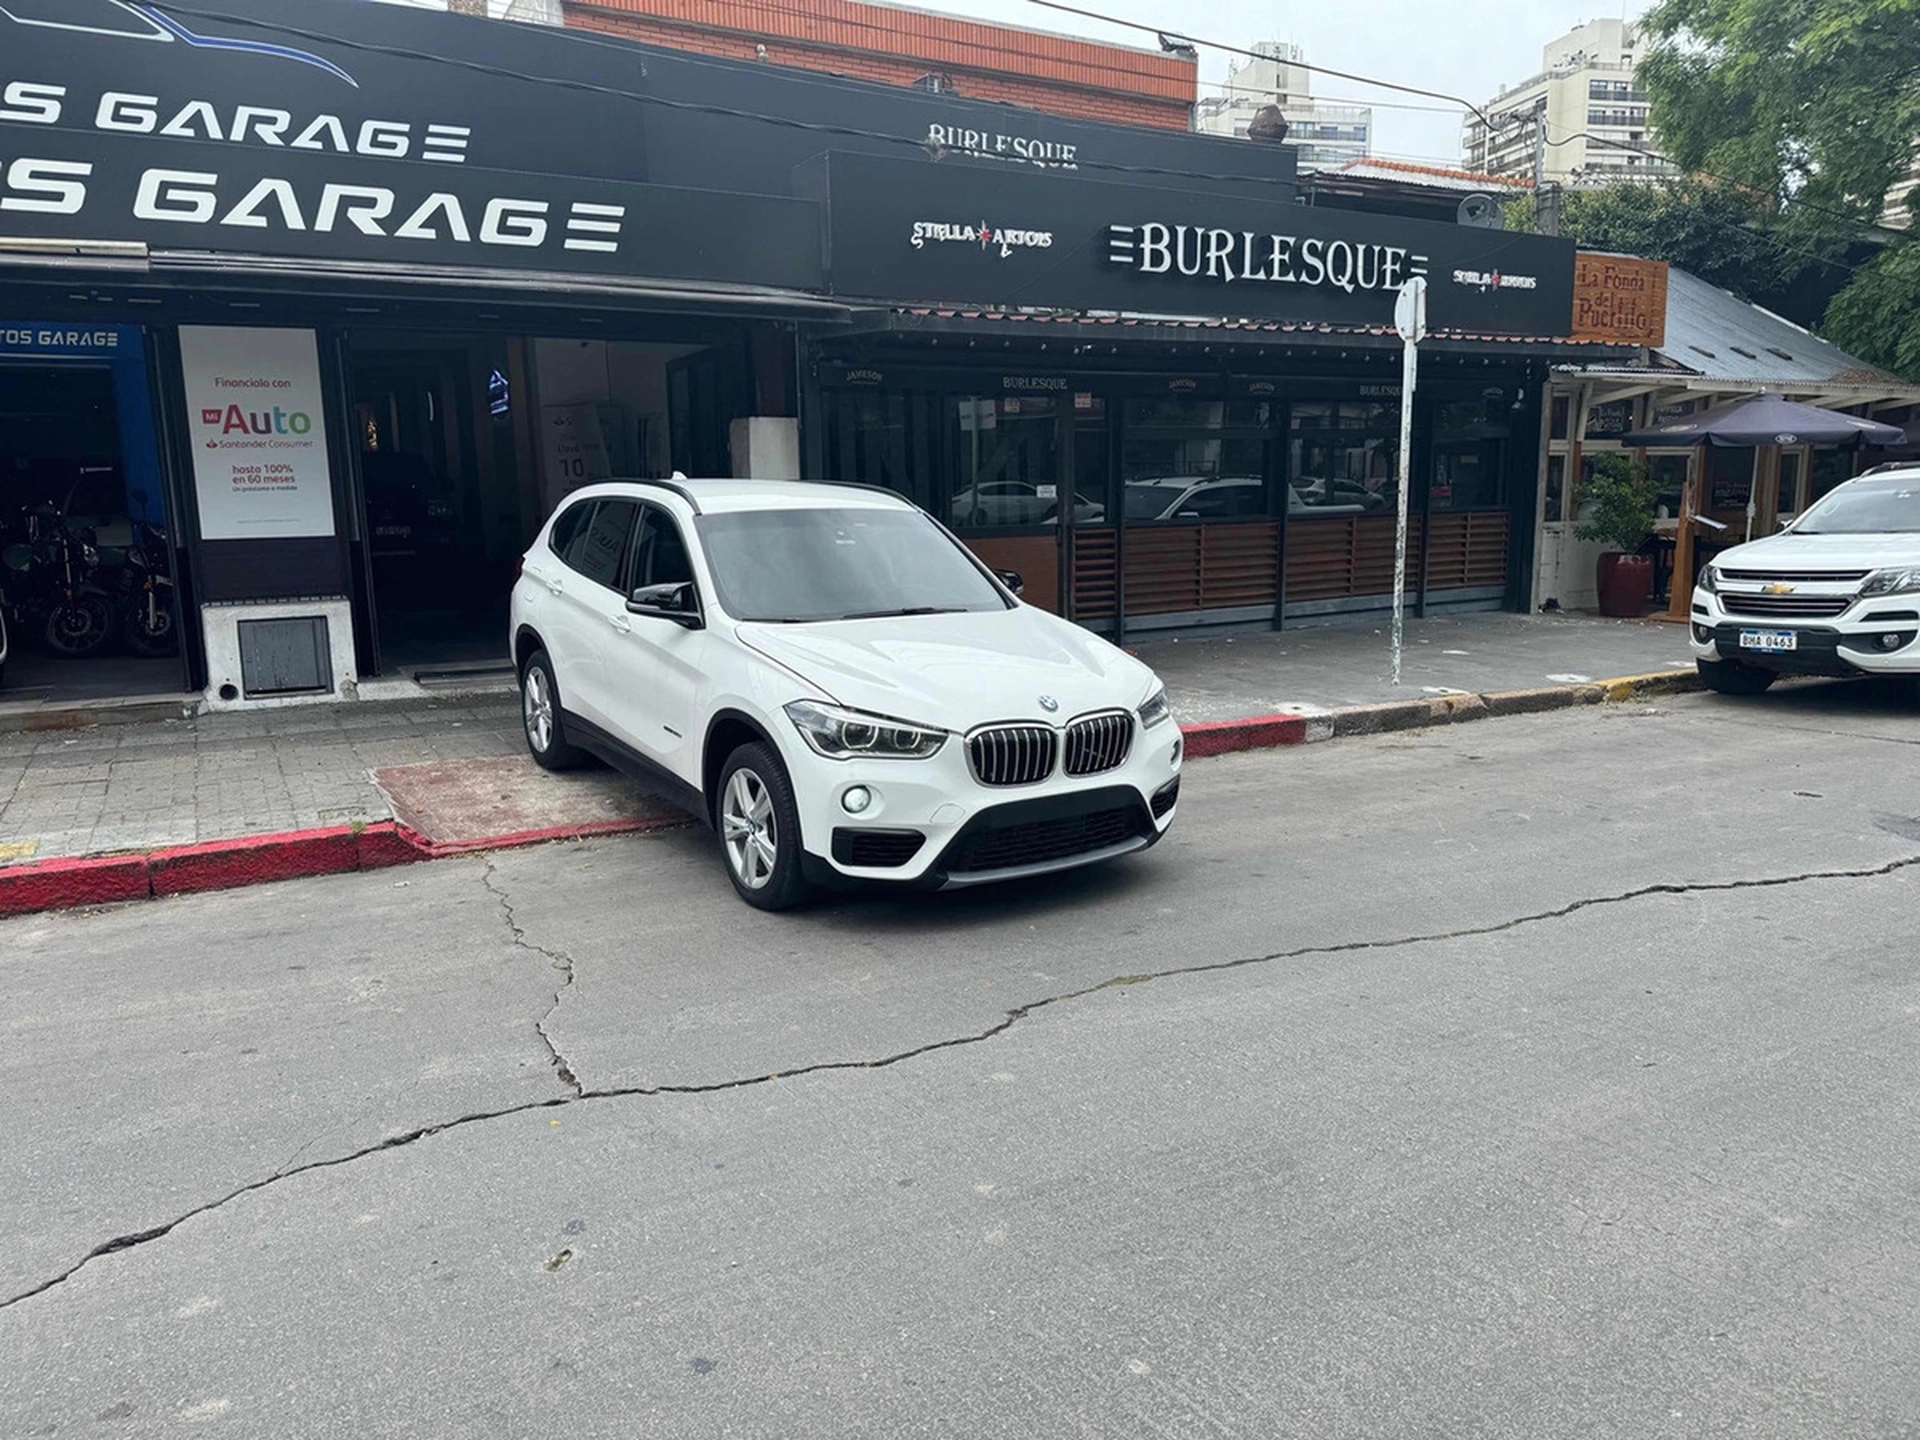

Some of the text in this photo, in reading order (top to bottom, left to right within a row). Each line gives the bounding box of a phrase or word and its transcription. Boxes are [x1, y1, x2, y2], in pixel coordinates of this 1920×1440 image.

[95, 91, 471, 163] GARAGE
[928, 123, 1078, 170] BURLESQUE
[133, 168, 625, 252] GARAGE
[910, 221, 1053, 258] STELLA ARTOIS
[1139, 222, 1407, 293] BURLESQUE
[38, 331, 118, 347] GARAGE
[272, 379, 292, 388] con
[1003, 377, 1068, 391] BURLESQUE
[205, 404, 312, 435] Mi Auto
[219, 439, 314, 449] Santander Consumer
[232, 464, 293, 475] hasta 100%
[232, 475, 296, 485] en 60 meses
